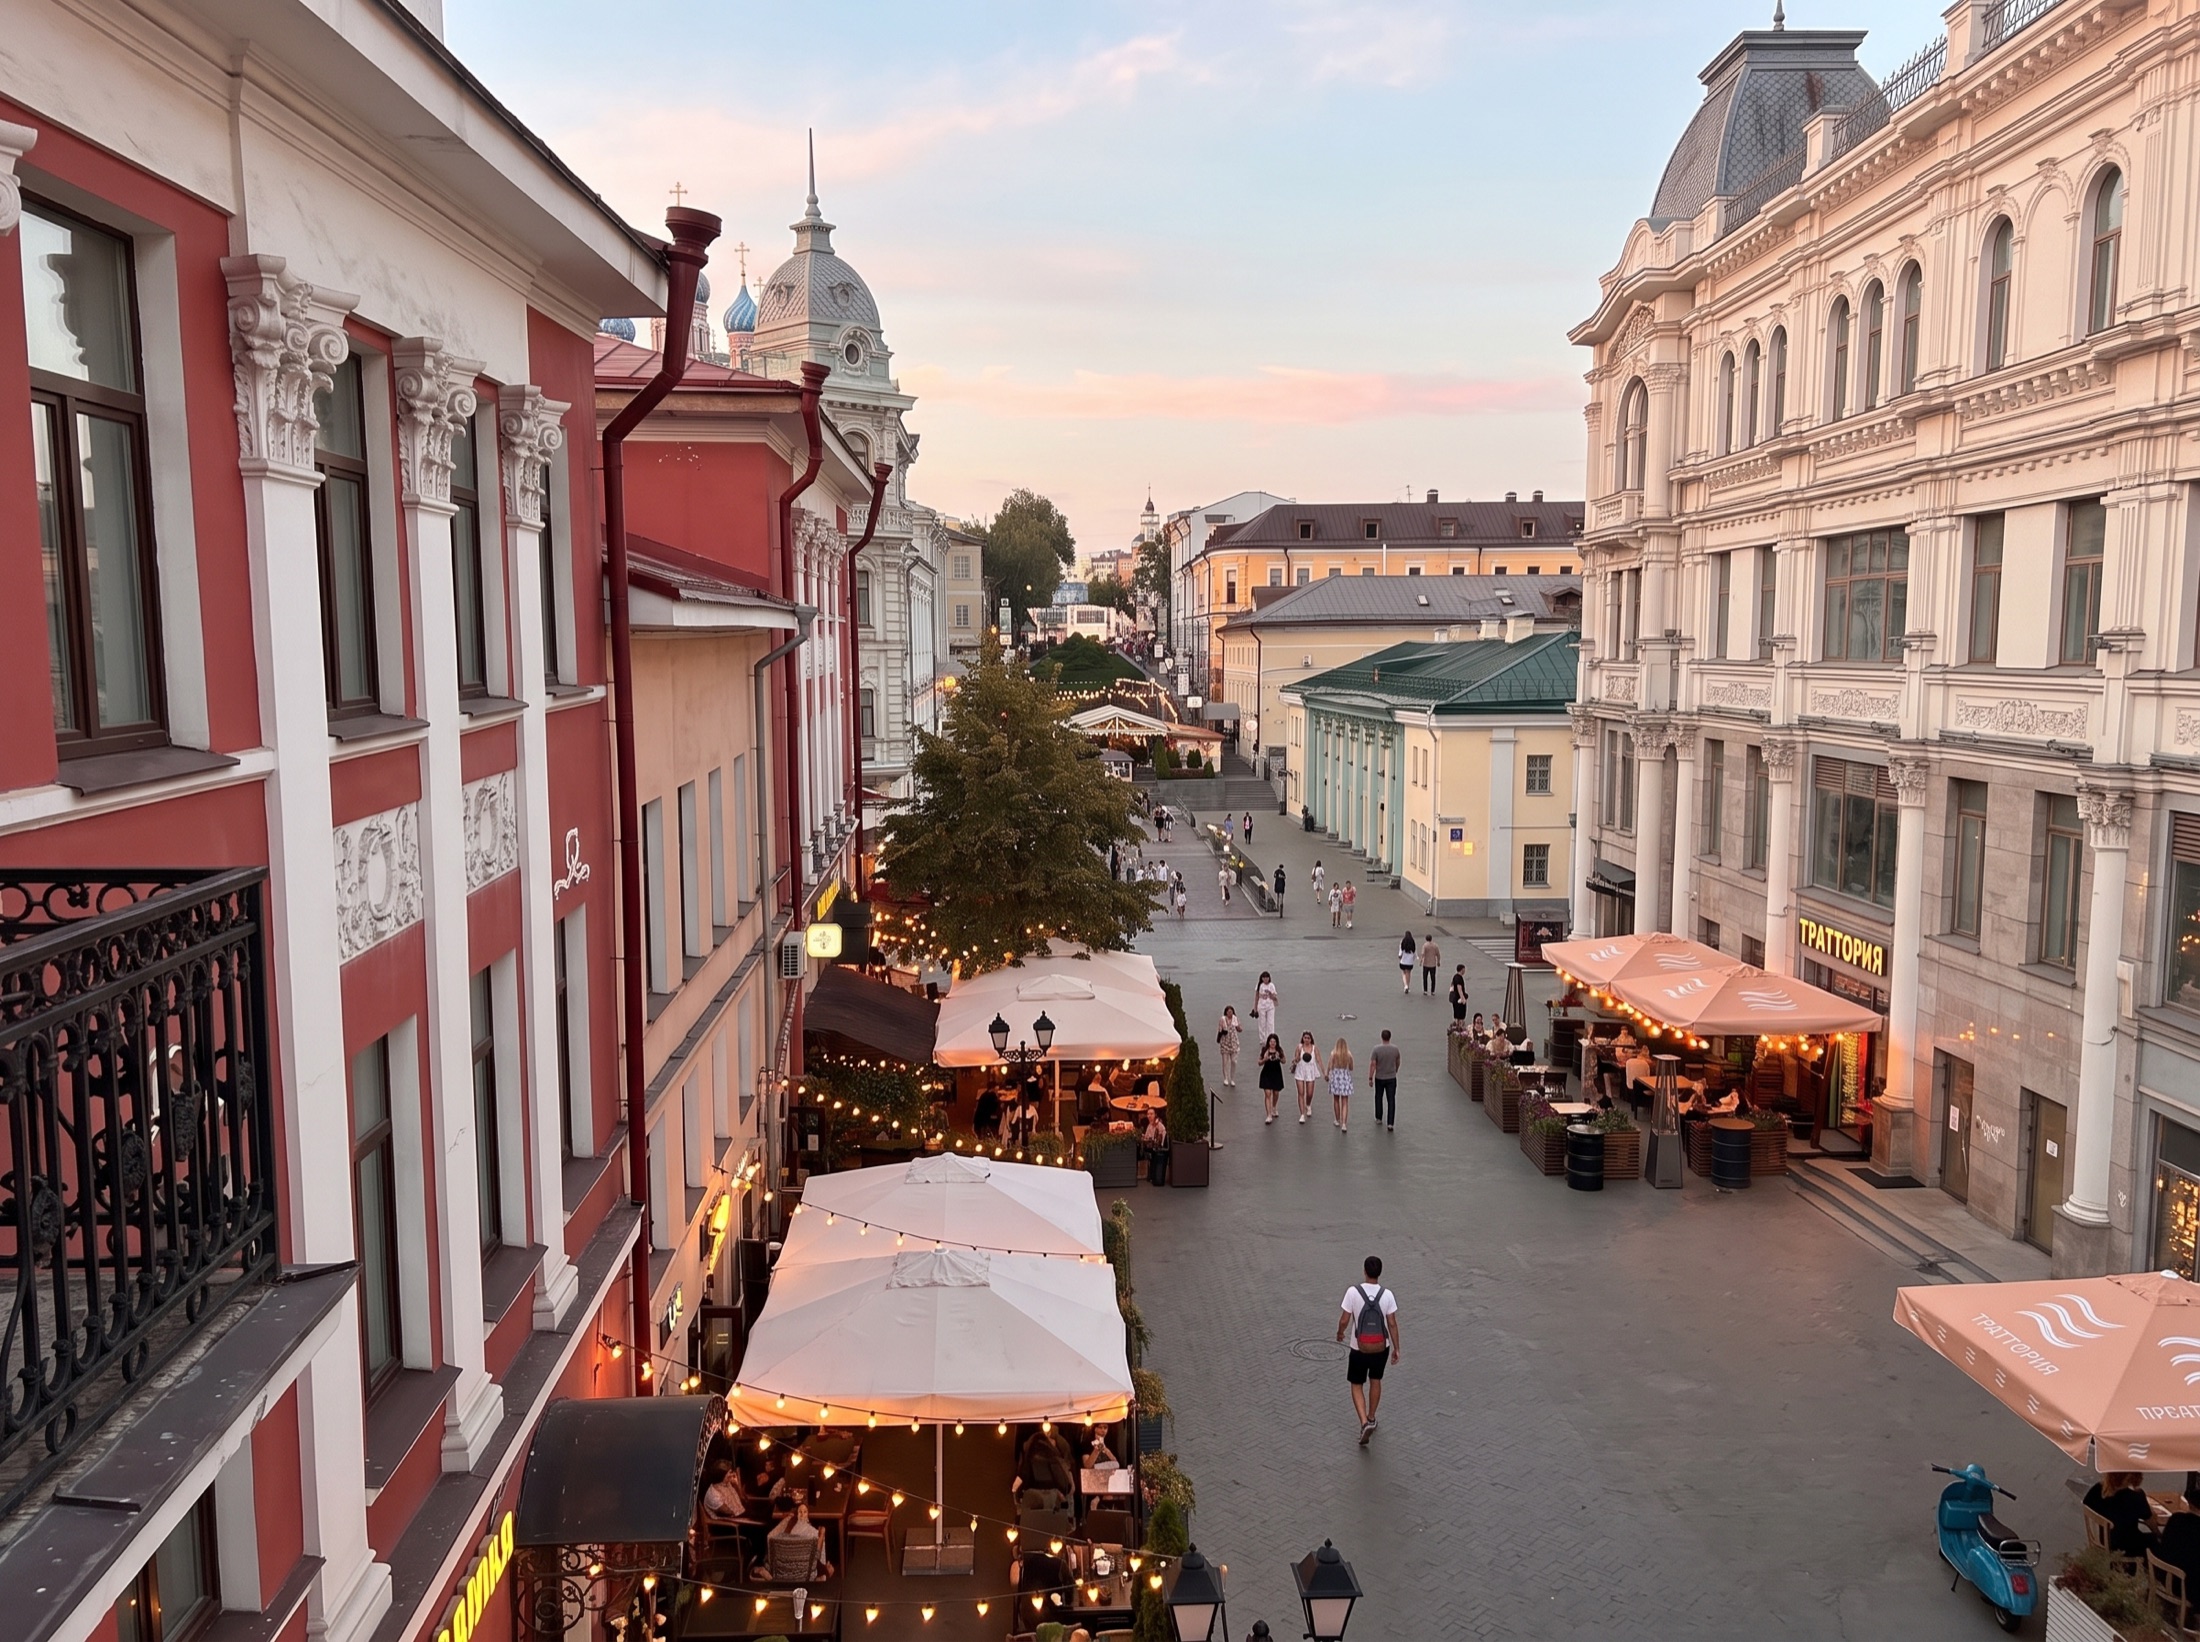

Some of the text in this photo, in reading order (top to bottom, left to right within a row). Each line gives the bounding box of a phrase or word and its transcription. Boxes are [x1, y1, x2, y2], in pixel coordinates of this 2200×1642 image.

[1799, 917, 1883, 977] ТРАТТОРИЯ
[1971, 1312, 2060, 1376] ТРАТТОРИЯ
[437, 1510, 514, 1642] АМКА
